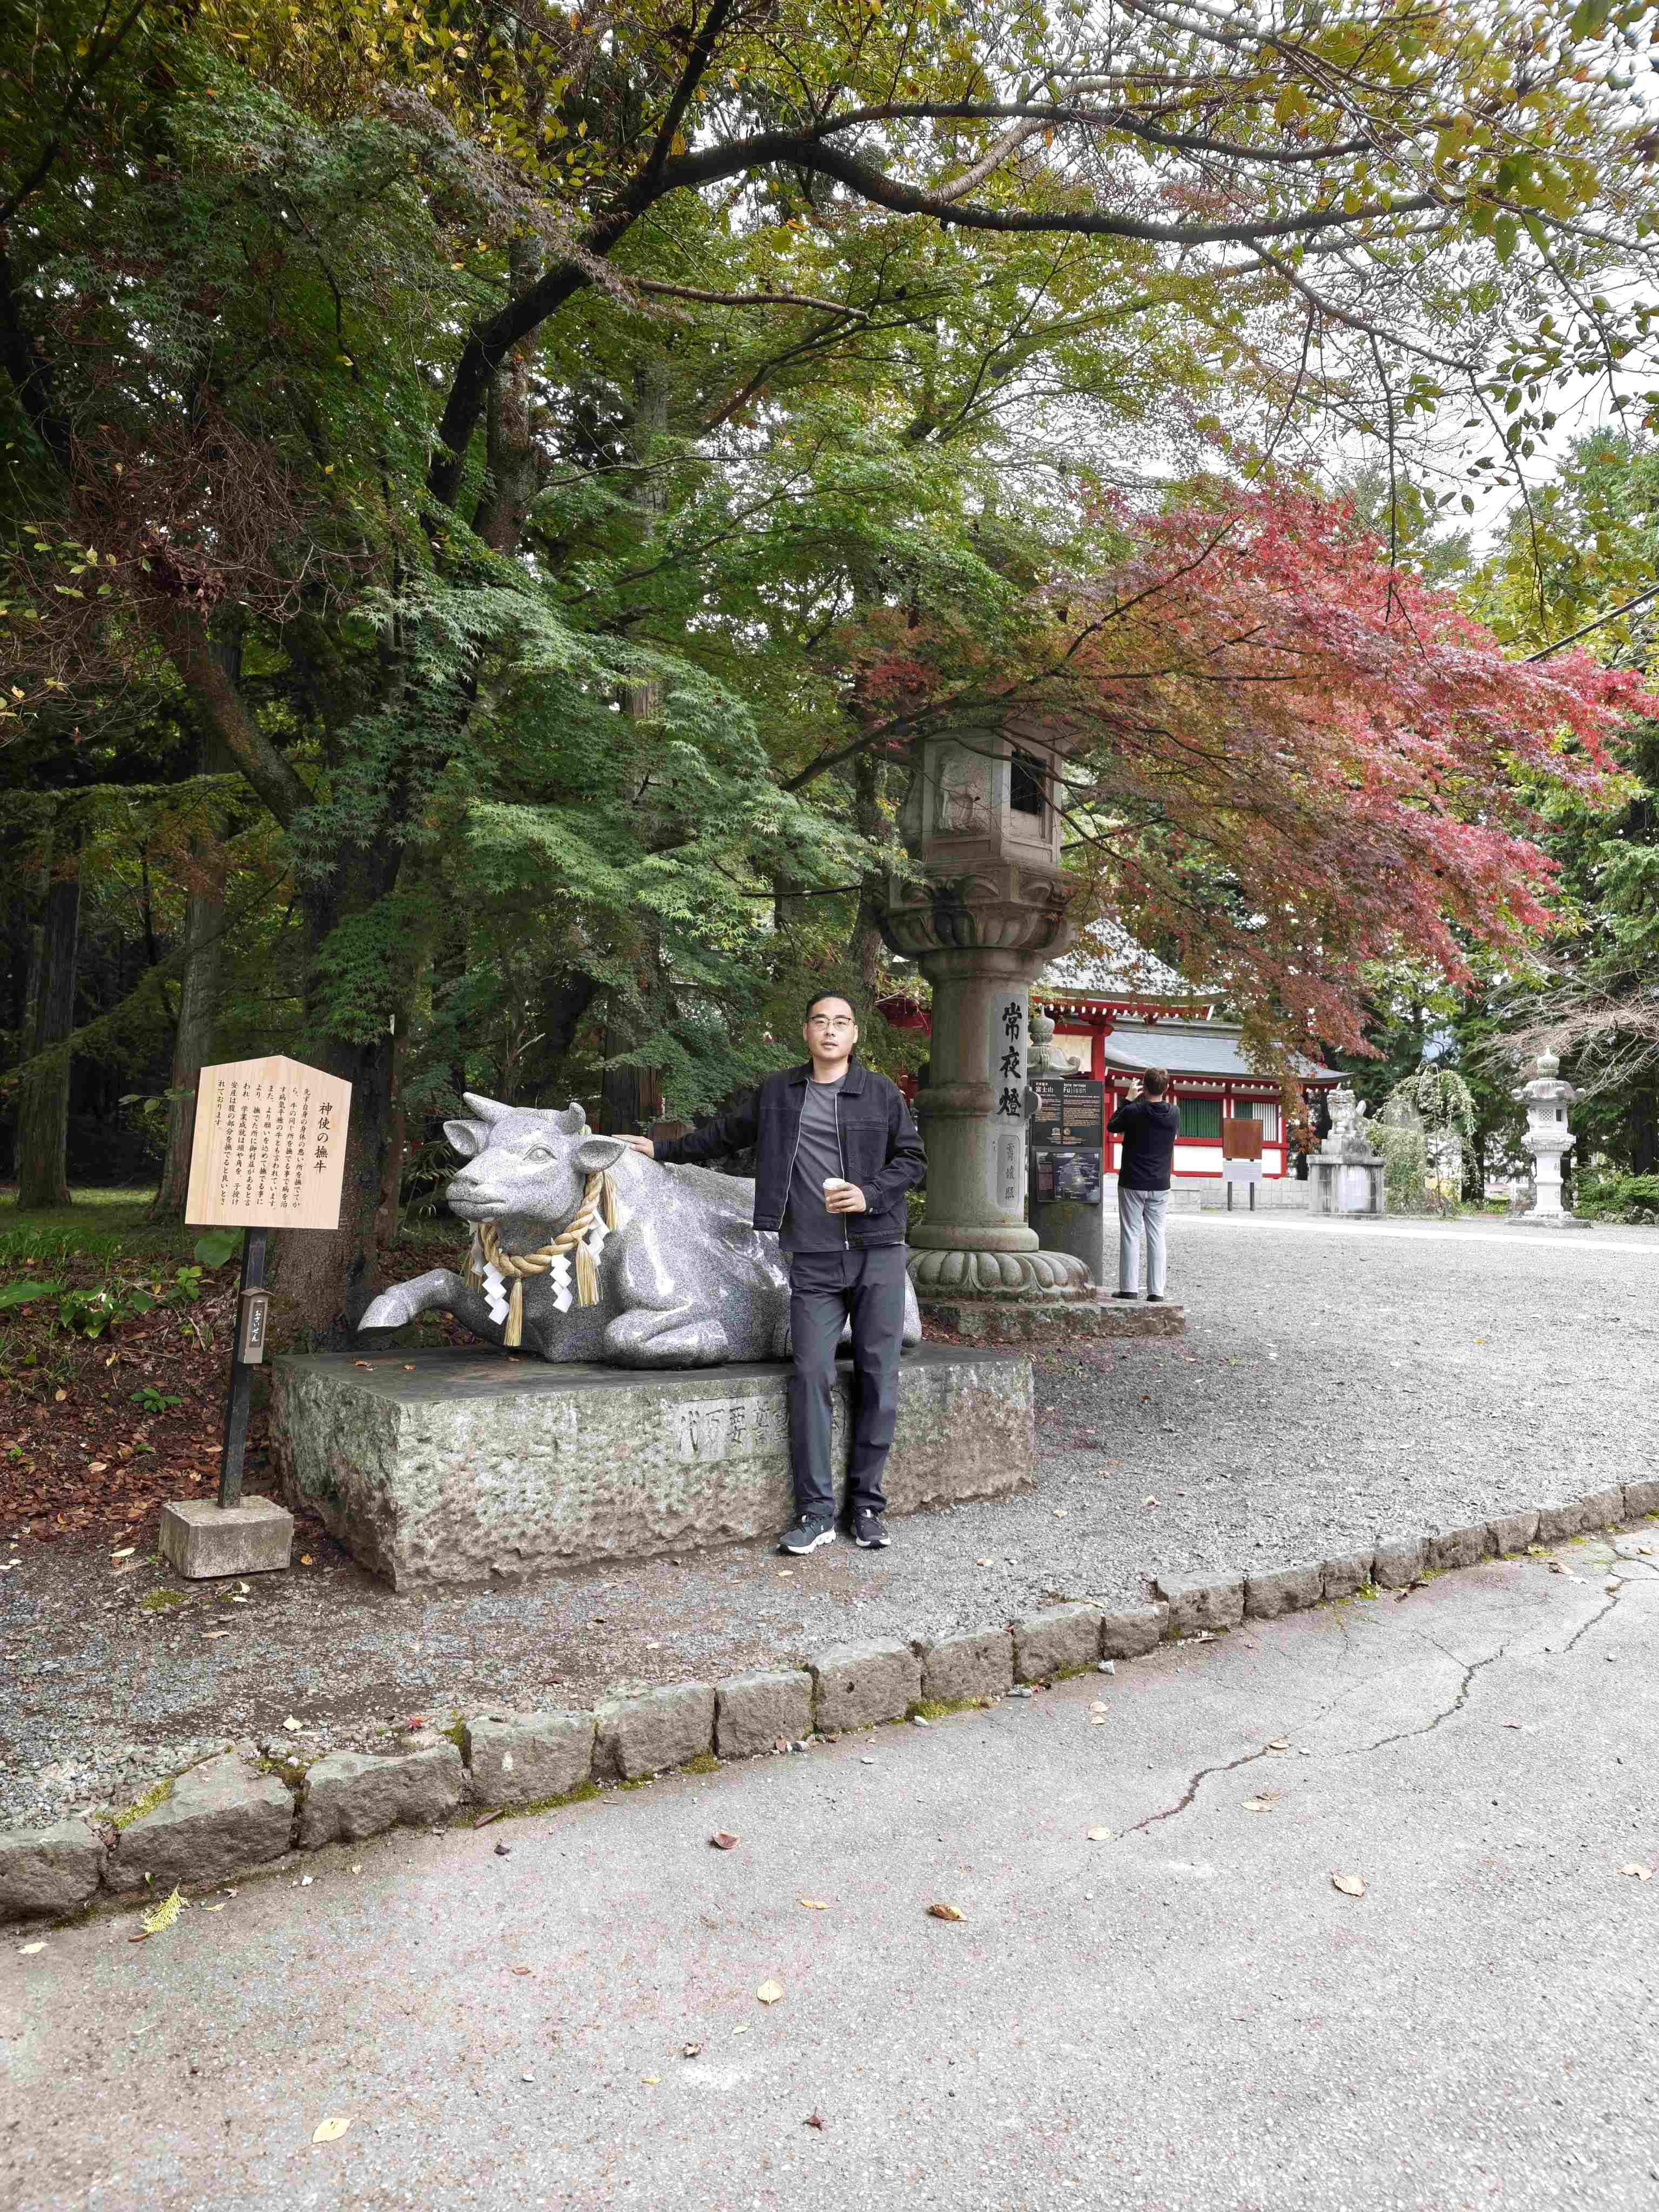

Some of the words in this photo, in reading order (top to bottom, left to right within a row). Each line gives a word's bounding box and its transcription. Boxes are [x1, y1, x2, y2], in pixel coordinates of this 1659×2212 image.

[997, 1002, 1023, 1117] 常夜燈
[313, 1102, 333, 1173] 神使の撫牛
[251, 1311, 261, 1342] おさいせん
